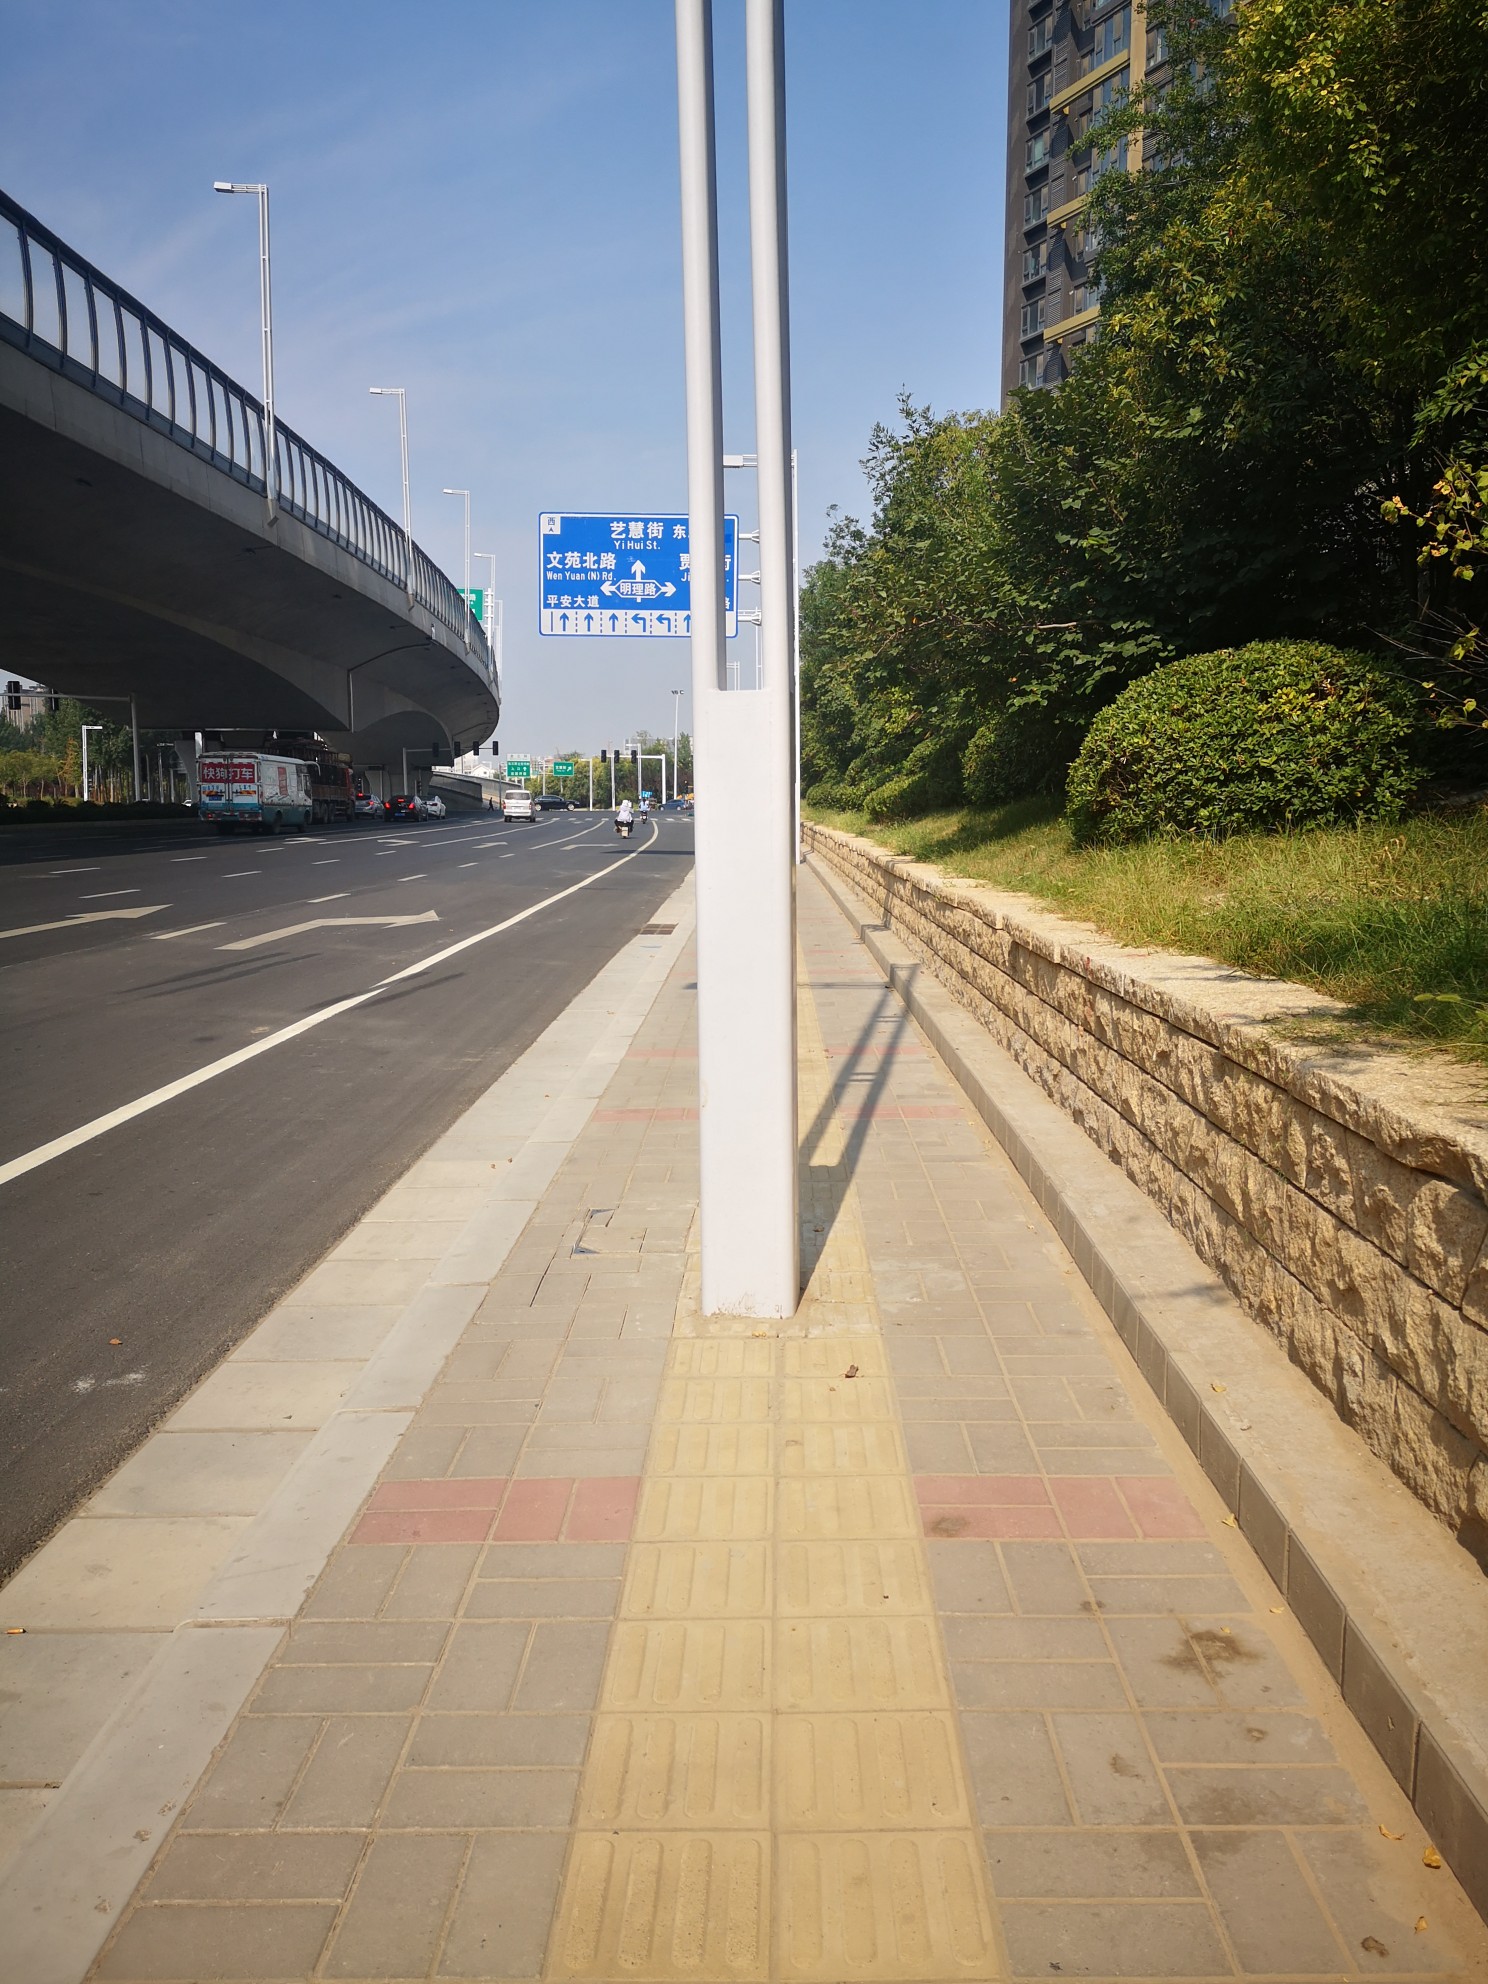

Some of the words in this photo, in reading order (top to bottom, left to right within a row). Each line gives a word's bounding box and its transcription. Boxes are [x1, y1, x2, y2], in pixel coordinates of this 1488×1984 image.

[547, 517, 555, 526] 西
[610, 522, 664, 539] 艺慧街
[614, 541, 625, 550] Yi
[627, 541, 644, 550] Hui
[646, 541, 661, 550] St.
[546, 551, 616, 570] 文苑北路
[546, 571, 563, 581] Wen
[565, 571, 585, 581] Yuan
[602, 571, 616, 581] Rd.
[620, 583, 656, 595] 明理路
[546, 595, 599, 608] 平安大道
[203, 767, 253, 780] 快狗打车
